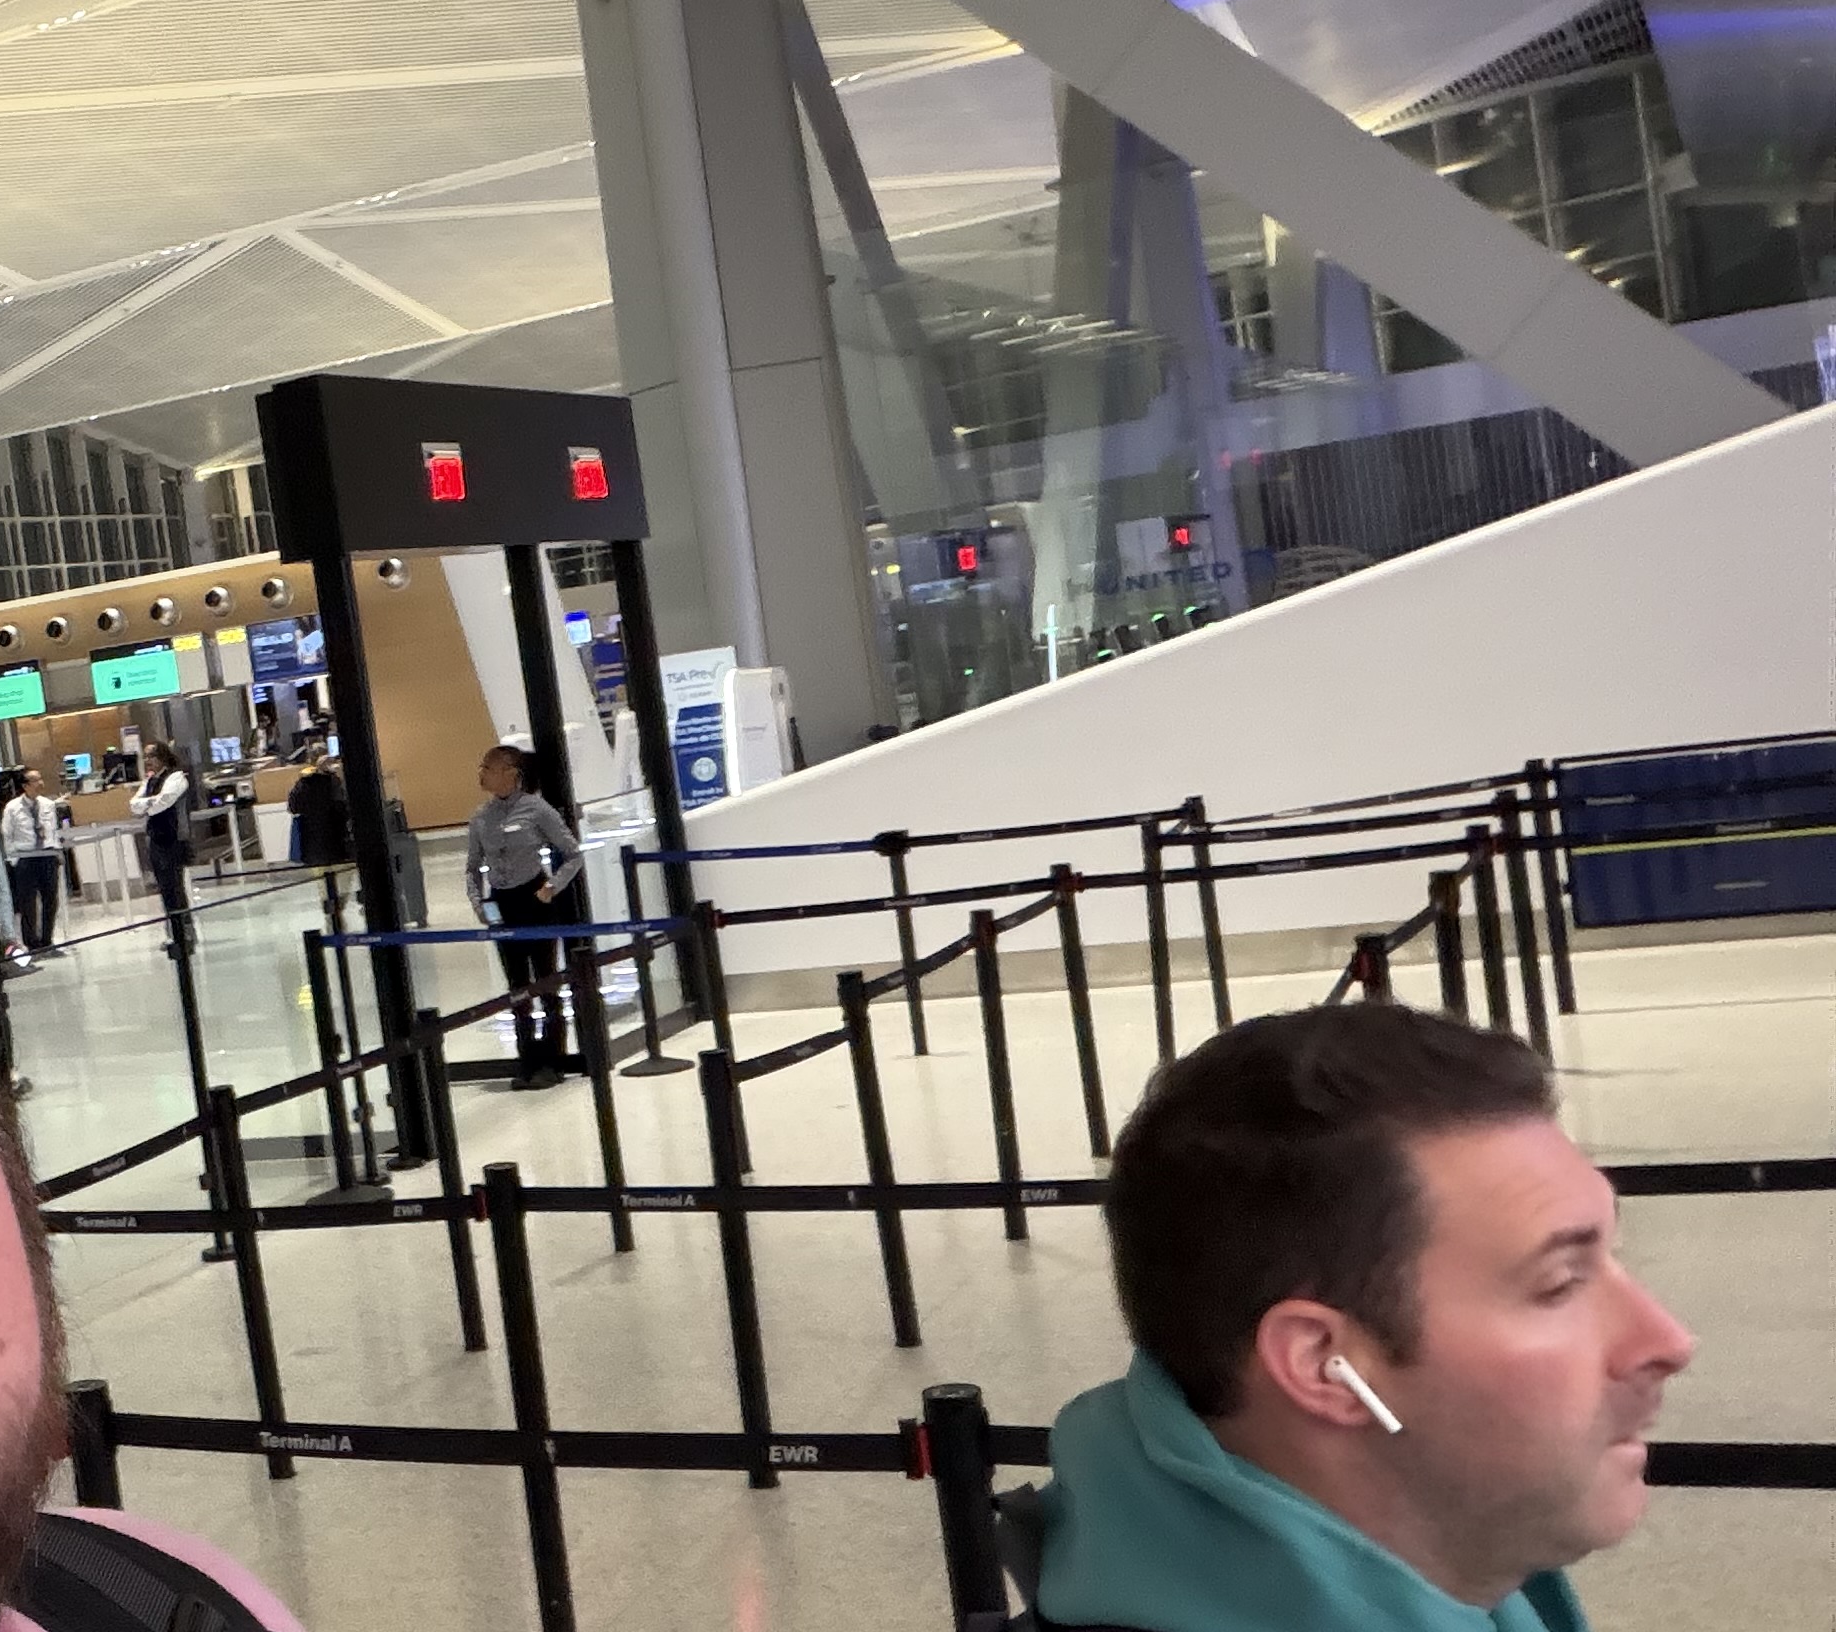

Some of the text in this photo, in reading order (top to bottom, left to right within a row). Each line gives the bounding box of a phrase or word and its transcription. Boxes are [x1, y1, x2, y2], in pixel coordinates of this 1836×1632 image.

[620, 1194, 696, 1208] Terminal A
[393, 1204, 424, 1217] EWR
[75, 1215, 127, 1228] Terminal
[259, 1431, 354, 1452] Terminal A
[768, 1445, 820, 1464] EWR
